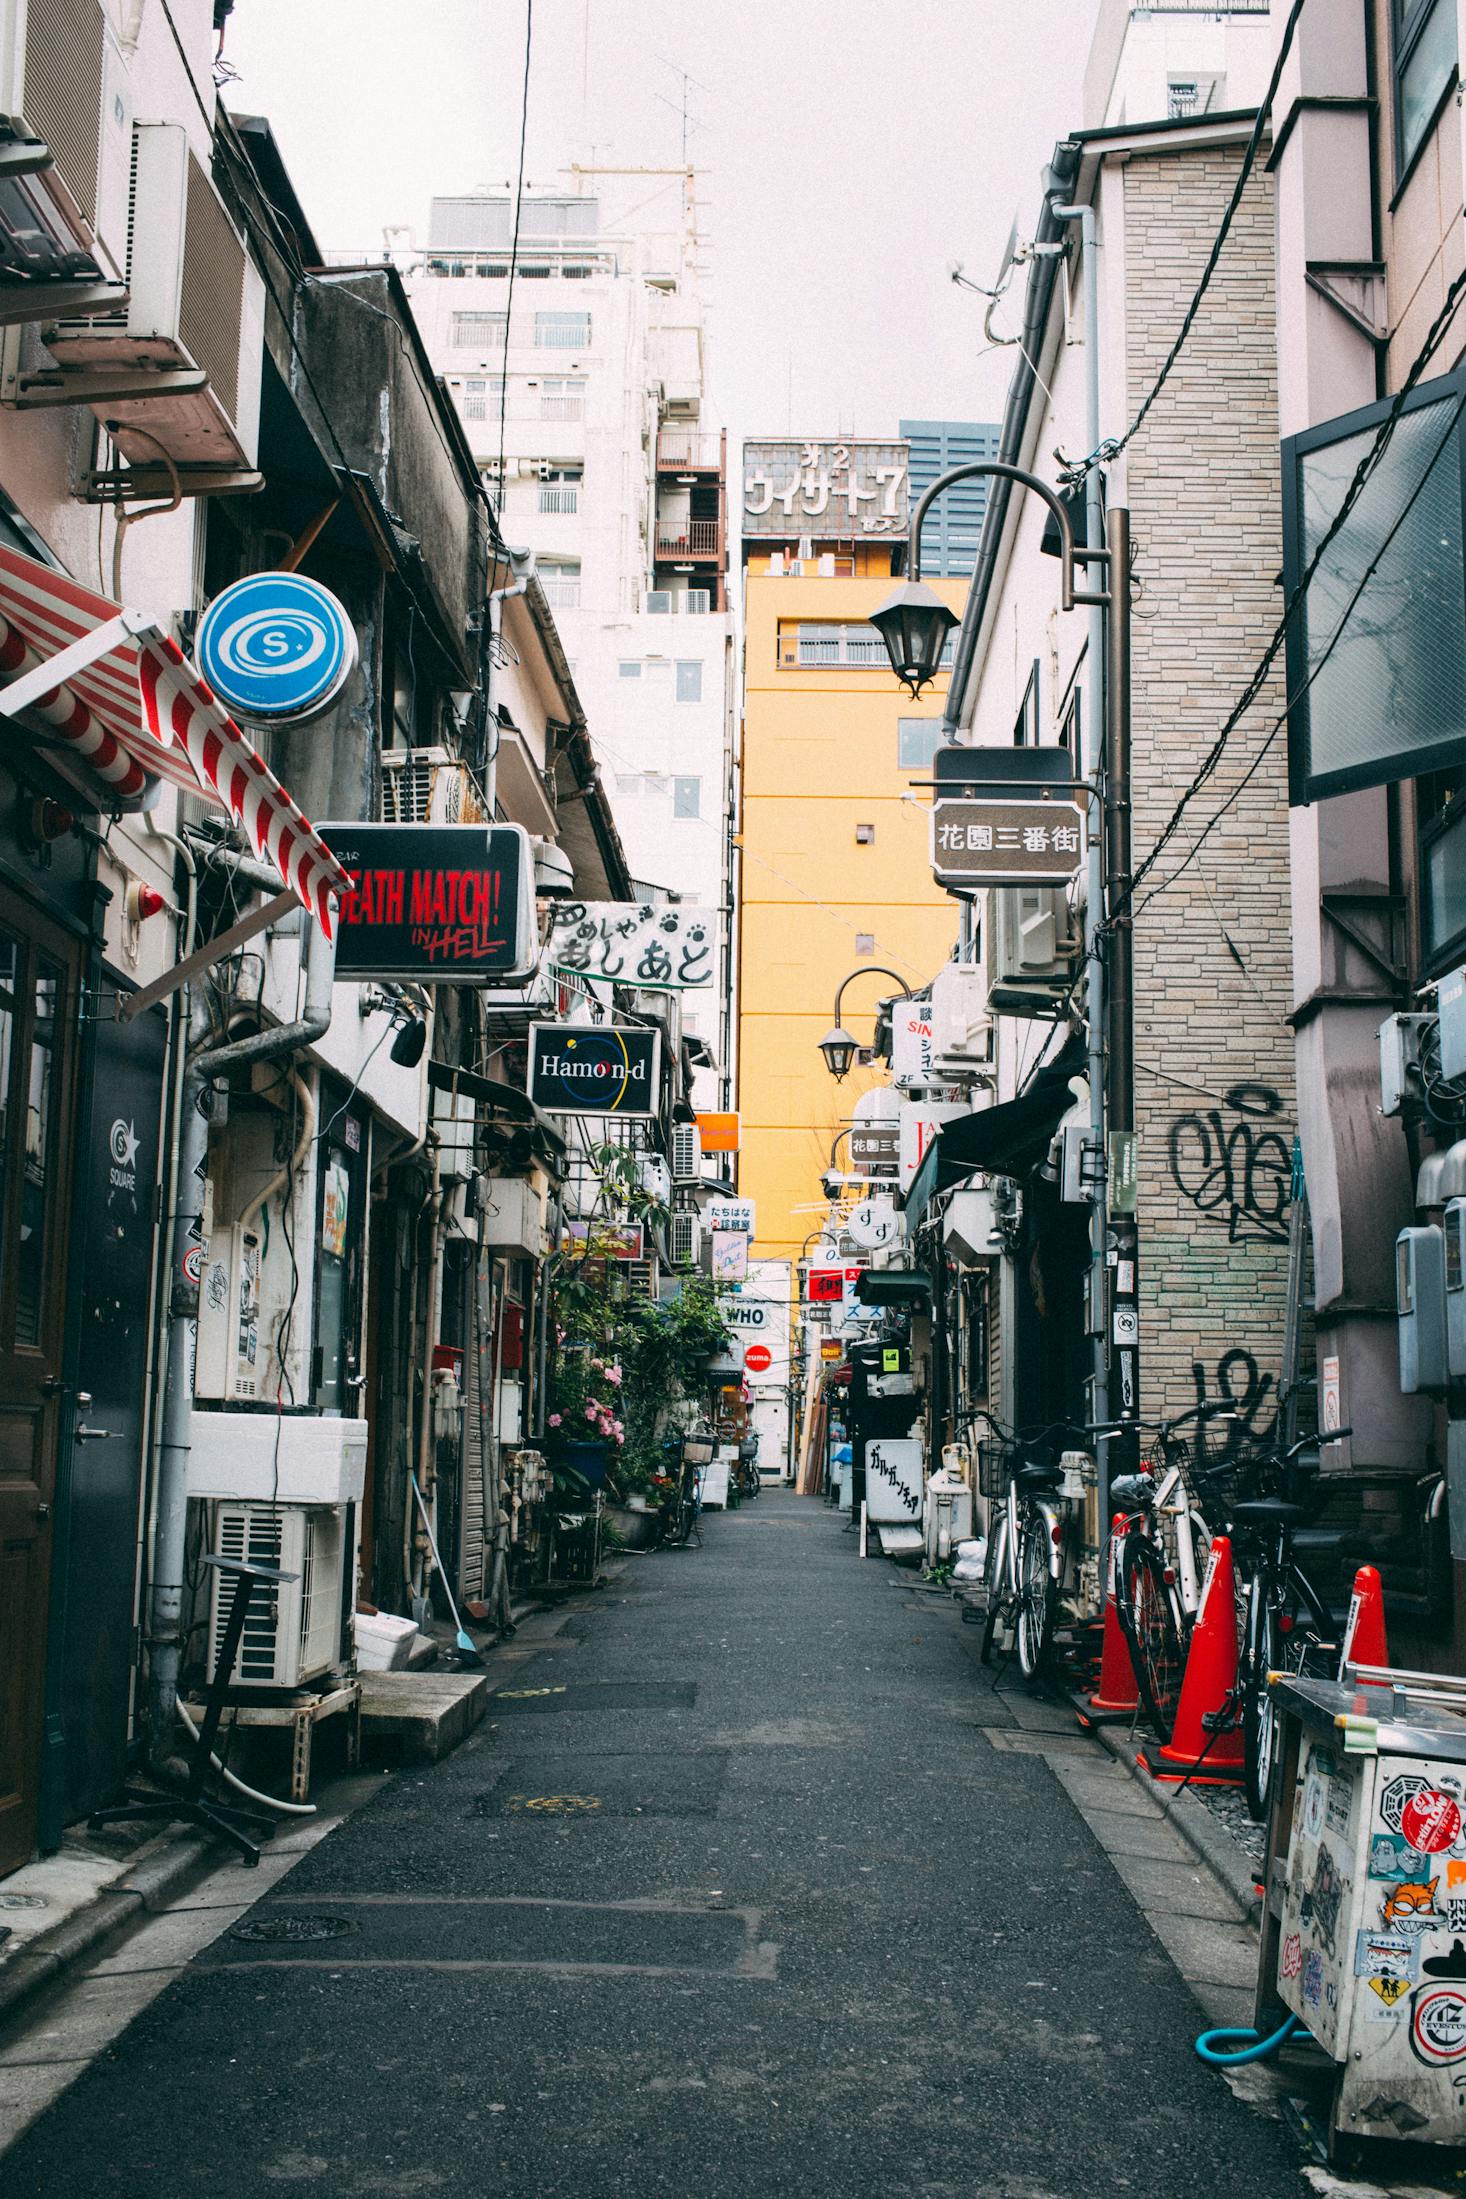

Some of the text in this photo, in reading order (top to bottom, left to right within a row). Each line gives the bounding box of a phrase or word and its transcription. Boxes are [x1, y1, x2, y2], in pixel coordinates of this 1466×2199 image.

[938, 824, 1079, 852] 花園三番街
[410, 869, 501, 925] MATCH!
[412, 920, 506, 961] IN HELL
[557, 939, 712, 983] あしあと
[901, 1075, 914, 1083] 2F
[110, 1168, 135, 1191] SQUARE
[727, 1308, 764, 1324] WHO
[871, 1445, 919, 1514] ガルガンチュア
